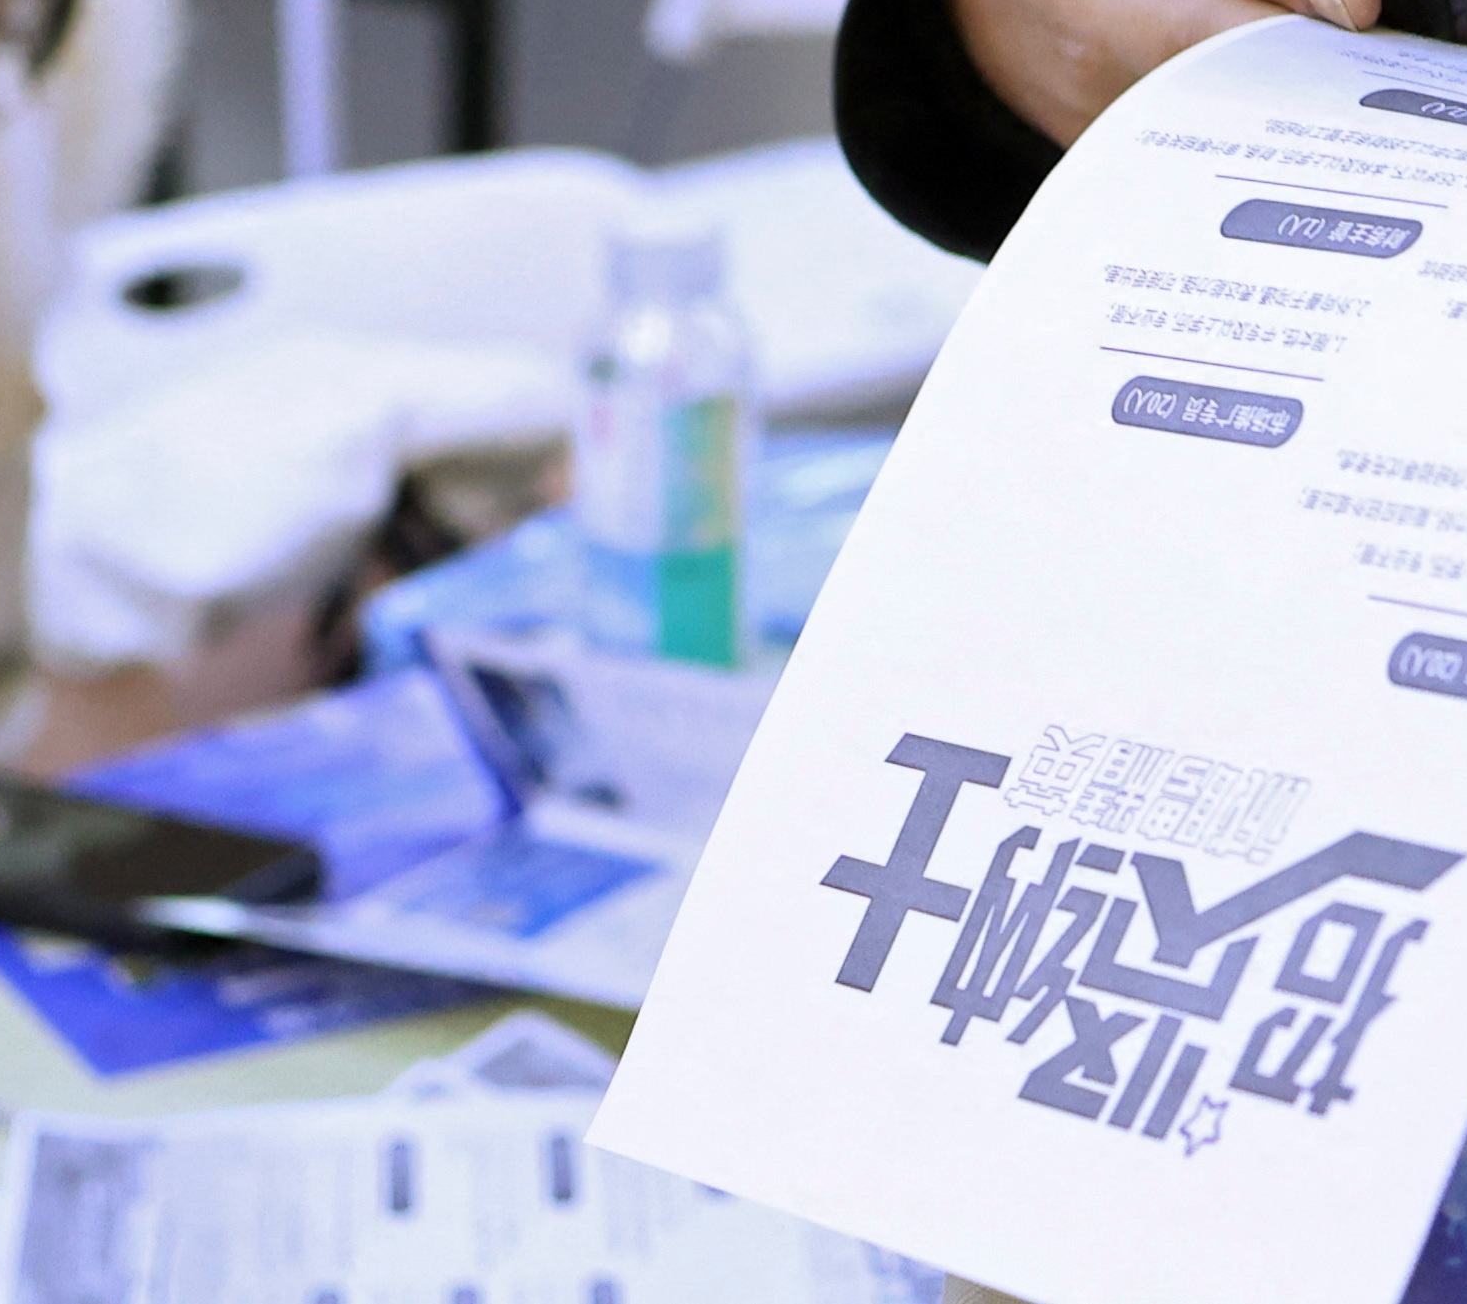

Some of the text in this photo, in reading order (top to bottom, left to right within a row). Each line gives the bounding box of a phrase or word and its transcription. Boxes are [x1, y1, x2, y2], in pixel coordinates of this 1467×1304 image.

[1004, 725, 1312, 864] 诚聘精英
[820, 733, 1467, 1139] 招贤纳士
